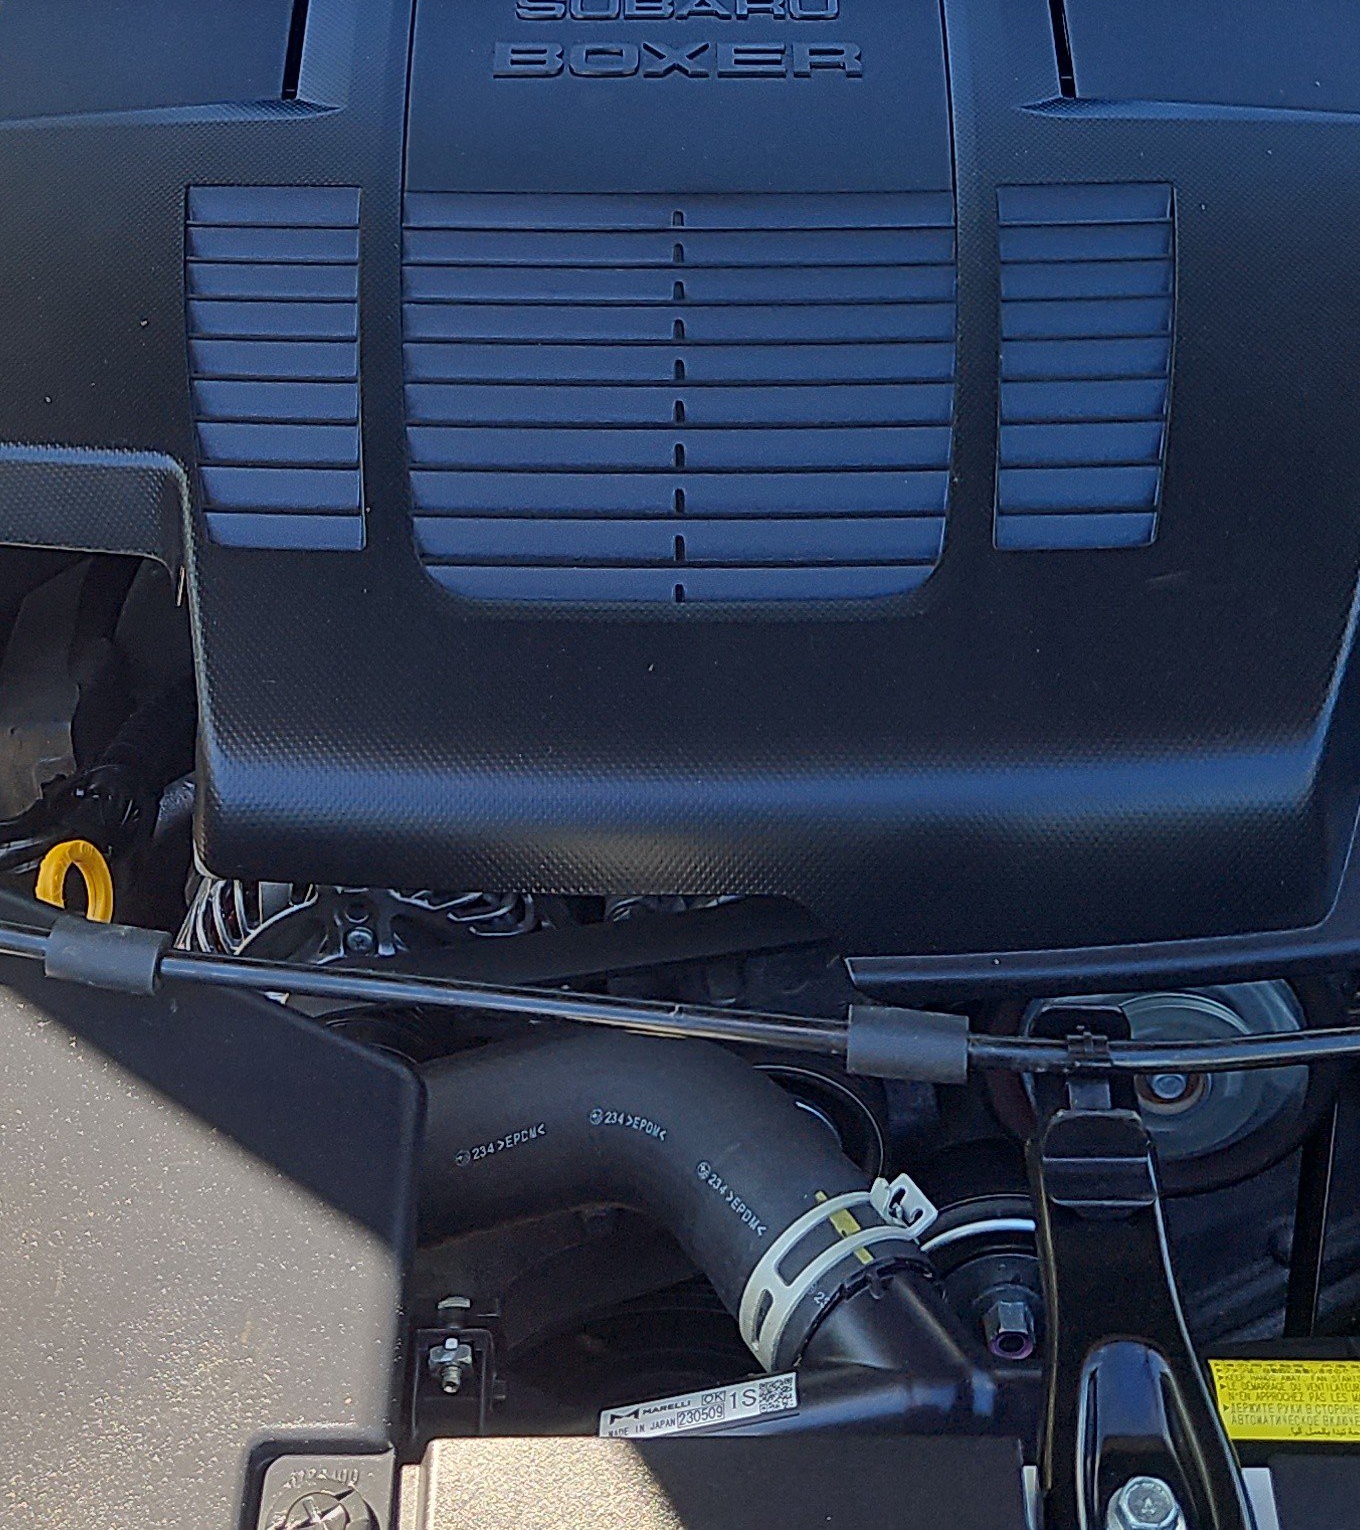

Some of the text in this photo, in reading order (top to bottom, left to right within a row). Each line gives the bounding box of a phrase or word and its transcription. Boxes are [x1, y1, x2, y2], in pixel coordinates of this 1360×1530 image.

[493, 42, 863, 79] BOXER
[1306, 1382, 1360, 1391] VENTILATEUR
[704, 1392, 722, 1403] OK
[1256, 1392, 1305, 1401] APPROCHEZ
[1310, 1392, 1325, 1402] PAS
[1331, 1393, 1348, 1402] LES
[643, 1400, 690, 1415] MARELLI
[678, 1407, 723, 1426] 230509
[635, 1424, 645, 1433] IN
[650, 1417, 676, 1431] JAPAN
